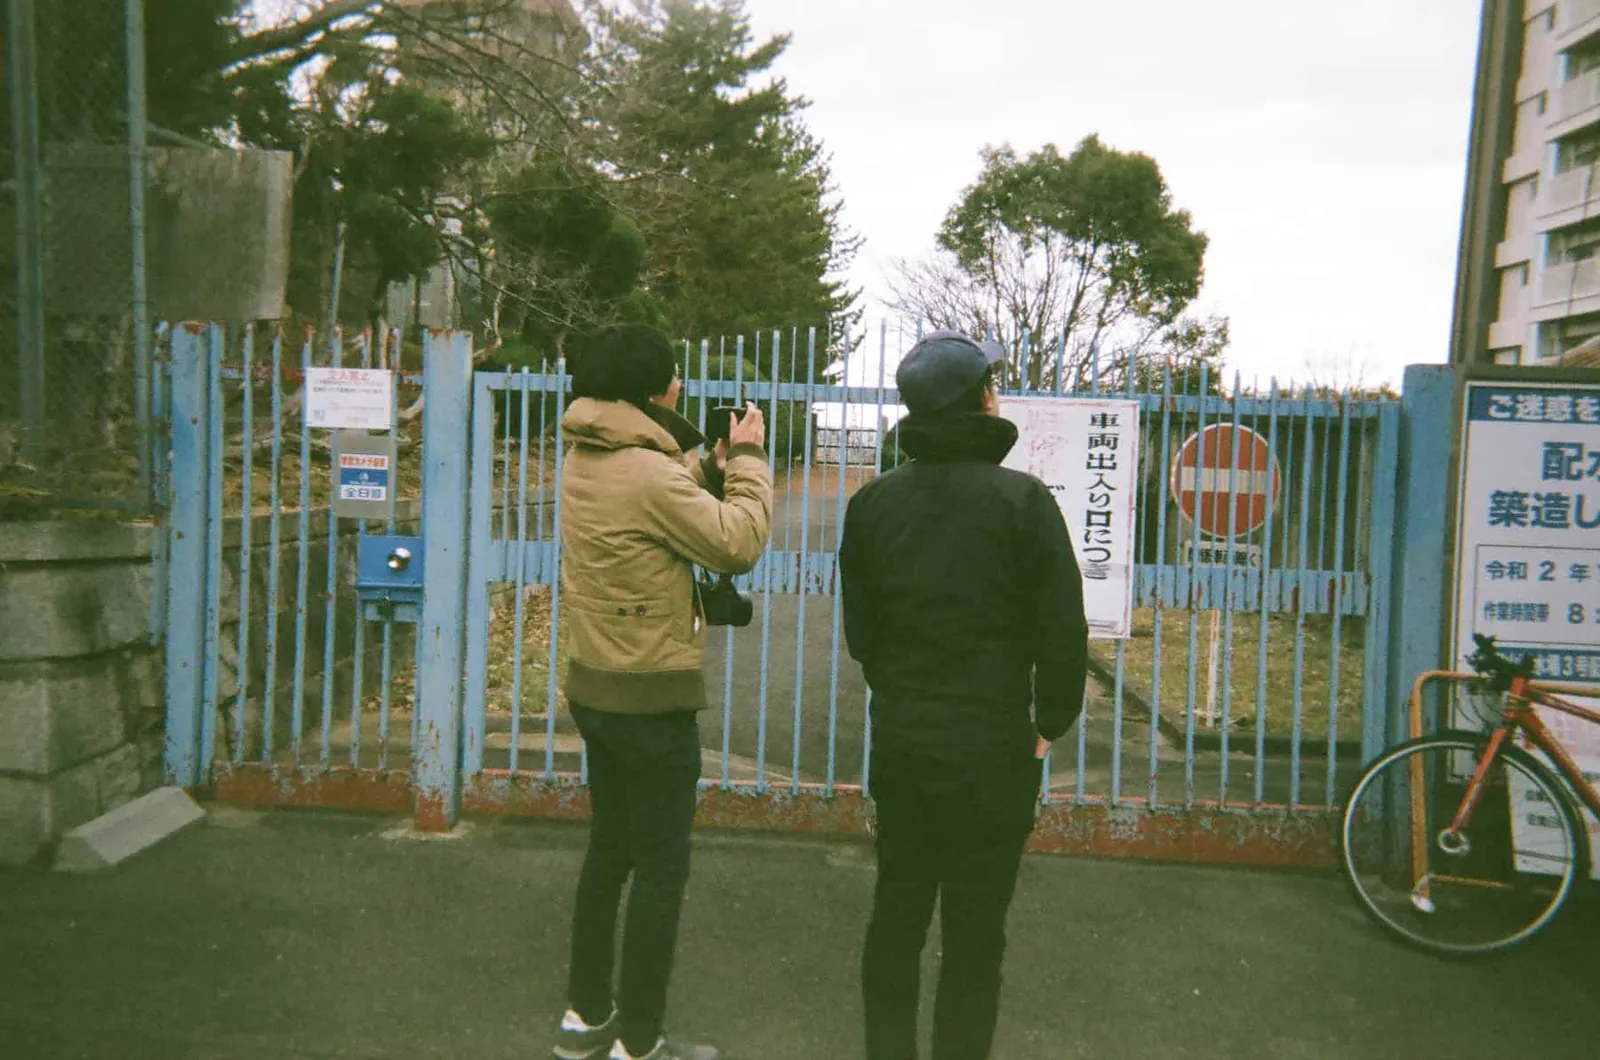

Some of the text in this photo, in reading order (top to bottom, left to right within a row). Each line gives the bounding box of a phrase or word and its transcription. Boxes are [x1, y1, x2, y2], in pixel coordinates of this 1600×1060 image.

[1488, 394, 1600, 421] ご迷惑を
[1488, 489, 1600, 529] 築造し
[1484, 560, 1600, 583] 令和2年
